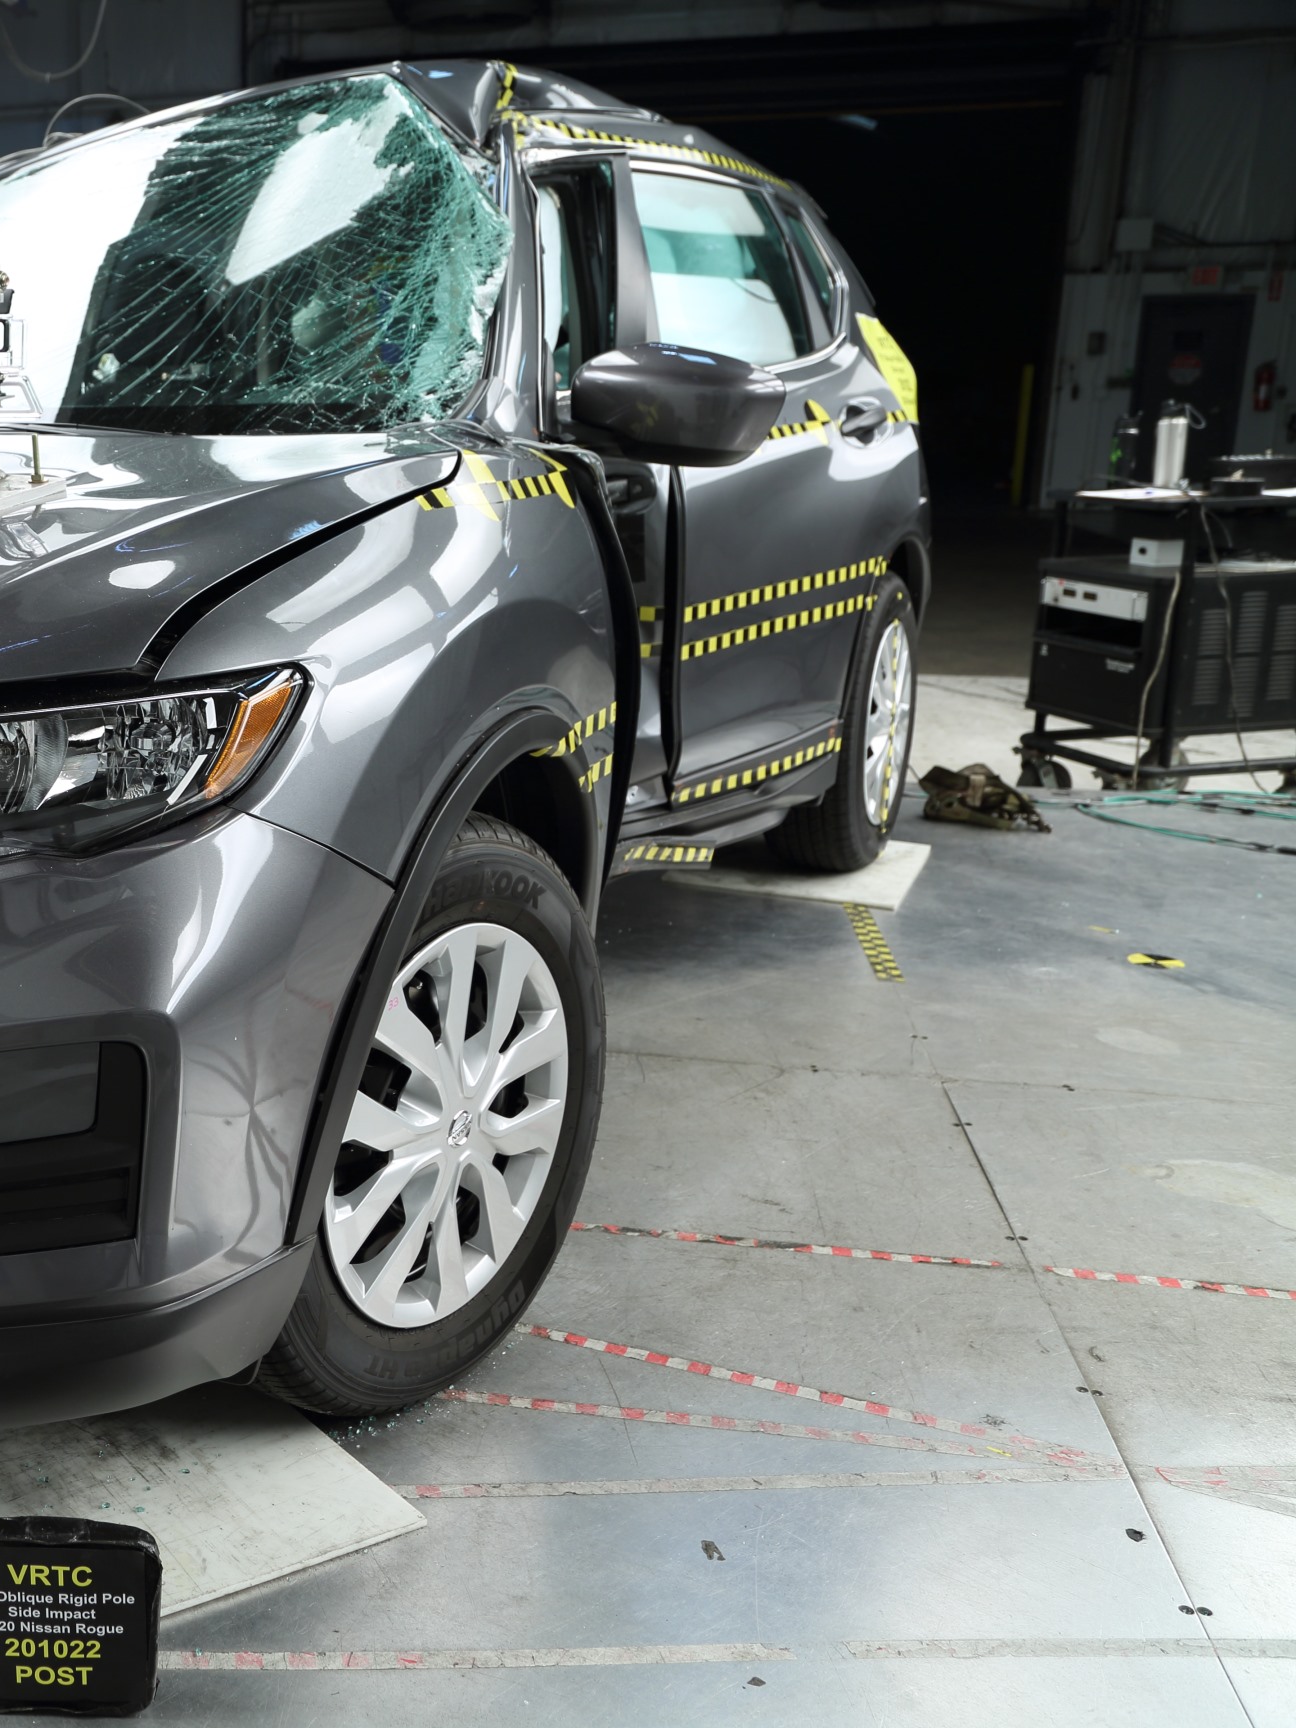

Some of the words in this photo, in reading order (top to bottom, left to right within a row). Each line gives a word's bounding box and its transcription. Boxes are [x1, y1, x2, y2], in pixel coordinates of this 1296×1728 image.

[7, 1563, 93, 1587] VRTC
[58, 1593, 98, 1608] Rigid
[102, 1592, 136, 1605] Pole
[7, 1605, 41, 1619] Side
[45, 1607, 97, 1622] Impact
[19, 1621, 71, 1634] Nissan
[75, 1622, 124, 1637] Rogue
[4, 1637, 102, 1659] 201022
[15, 1665, 94, 1686] POST
